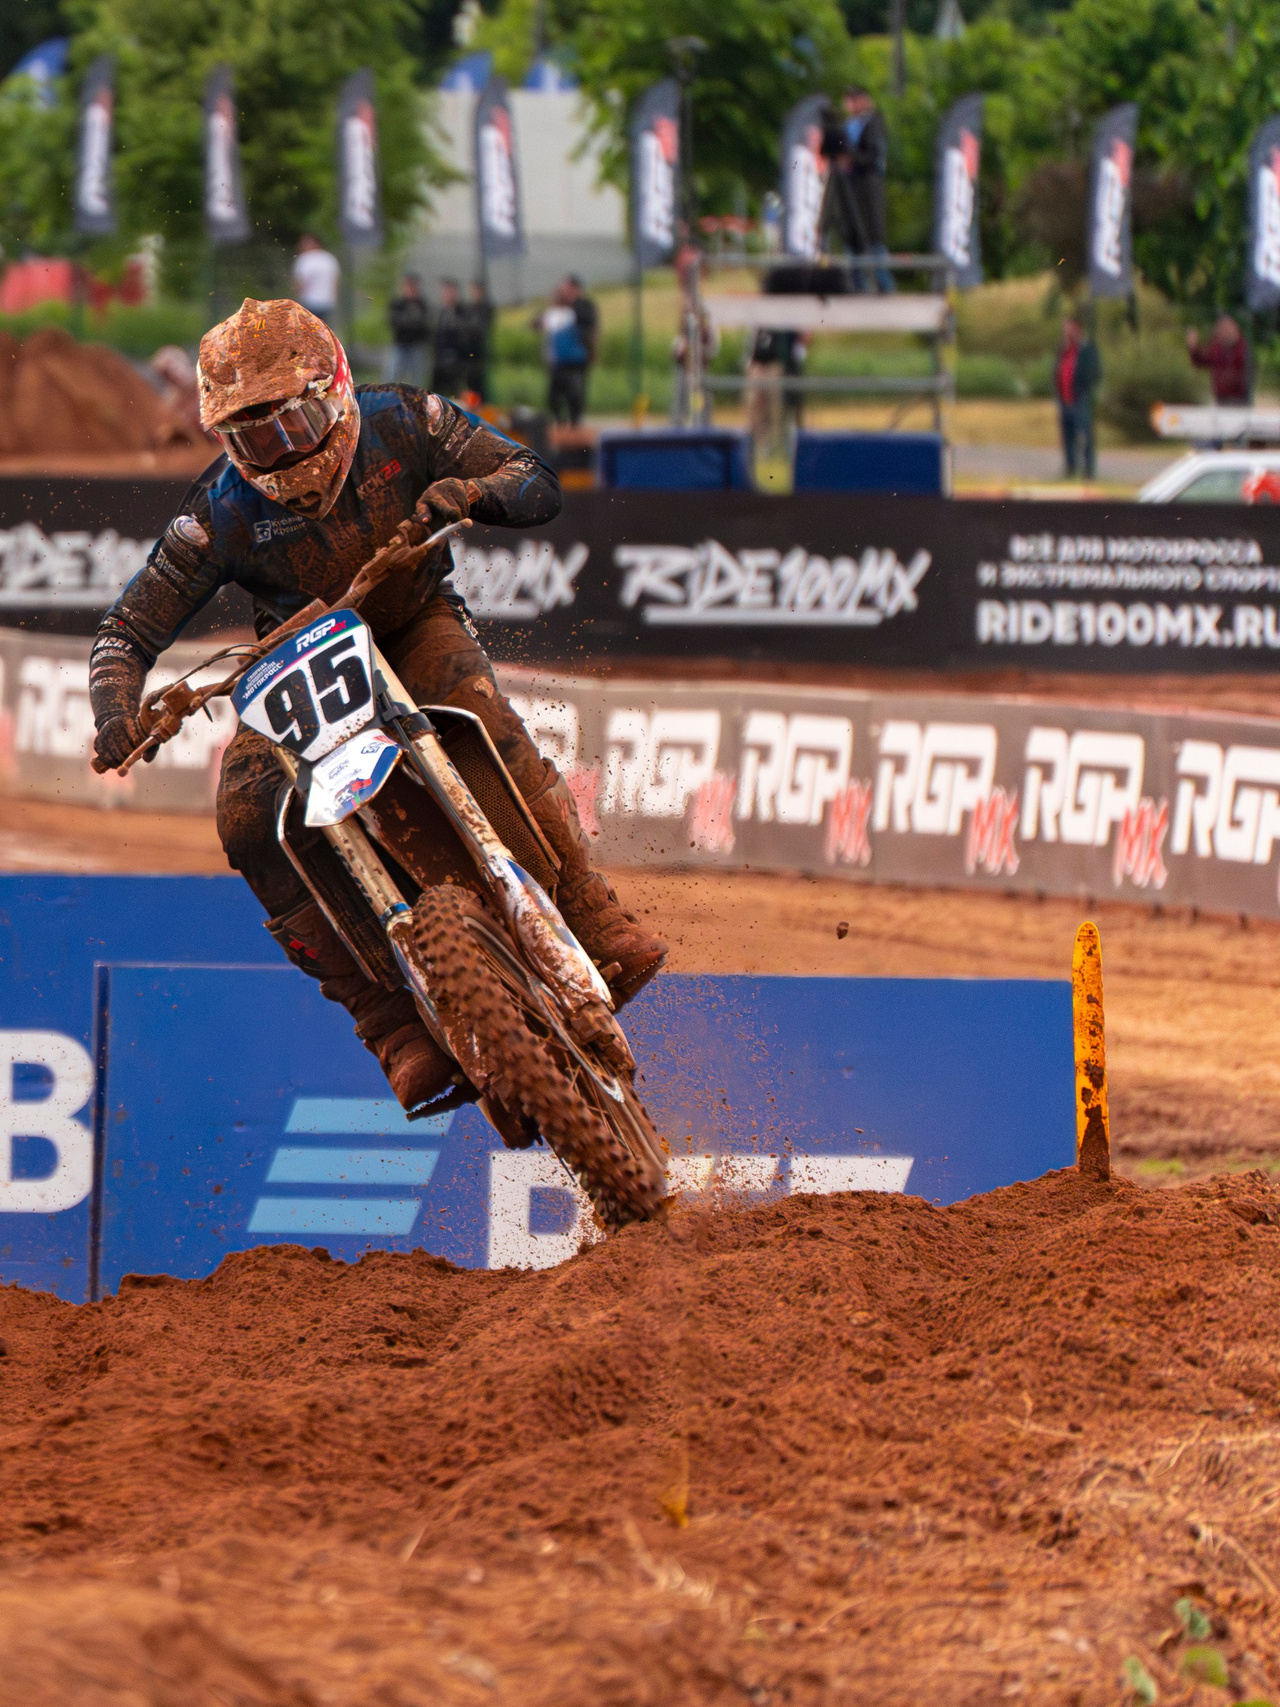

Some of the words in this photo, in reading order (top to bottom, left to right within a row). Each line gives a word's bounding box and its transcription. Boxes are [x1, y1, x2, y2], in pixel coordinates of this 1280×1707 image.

[614, 538, 932, 616] RIDE100MX
[295, 618, 337, 653] RGP
[264, 634, 372, 757] 95
[737, 710, 853, 825] RGP
[872, 719, 998, 836] RGP
[1020, 726, 1145, 848] RGP
